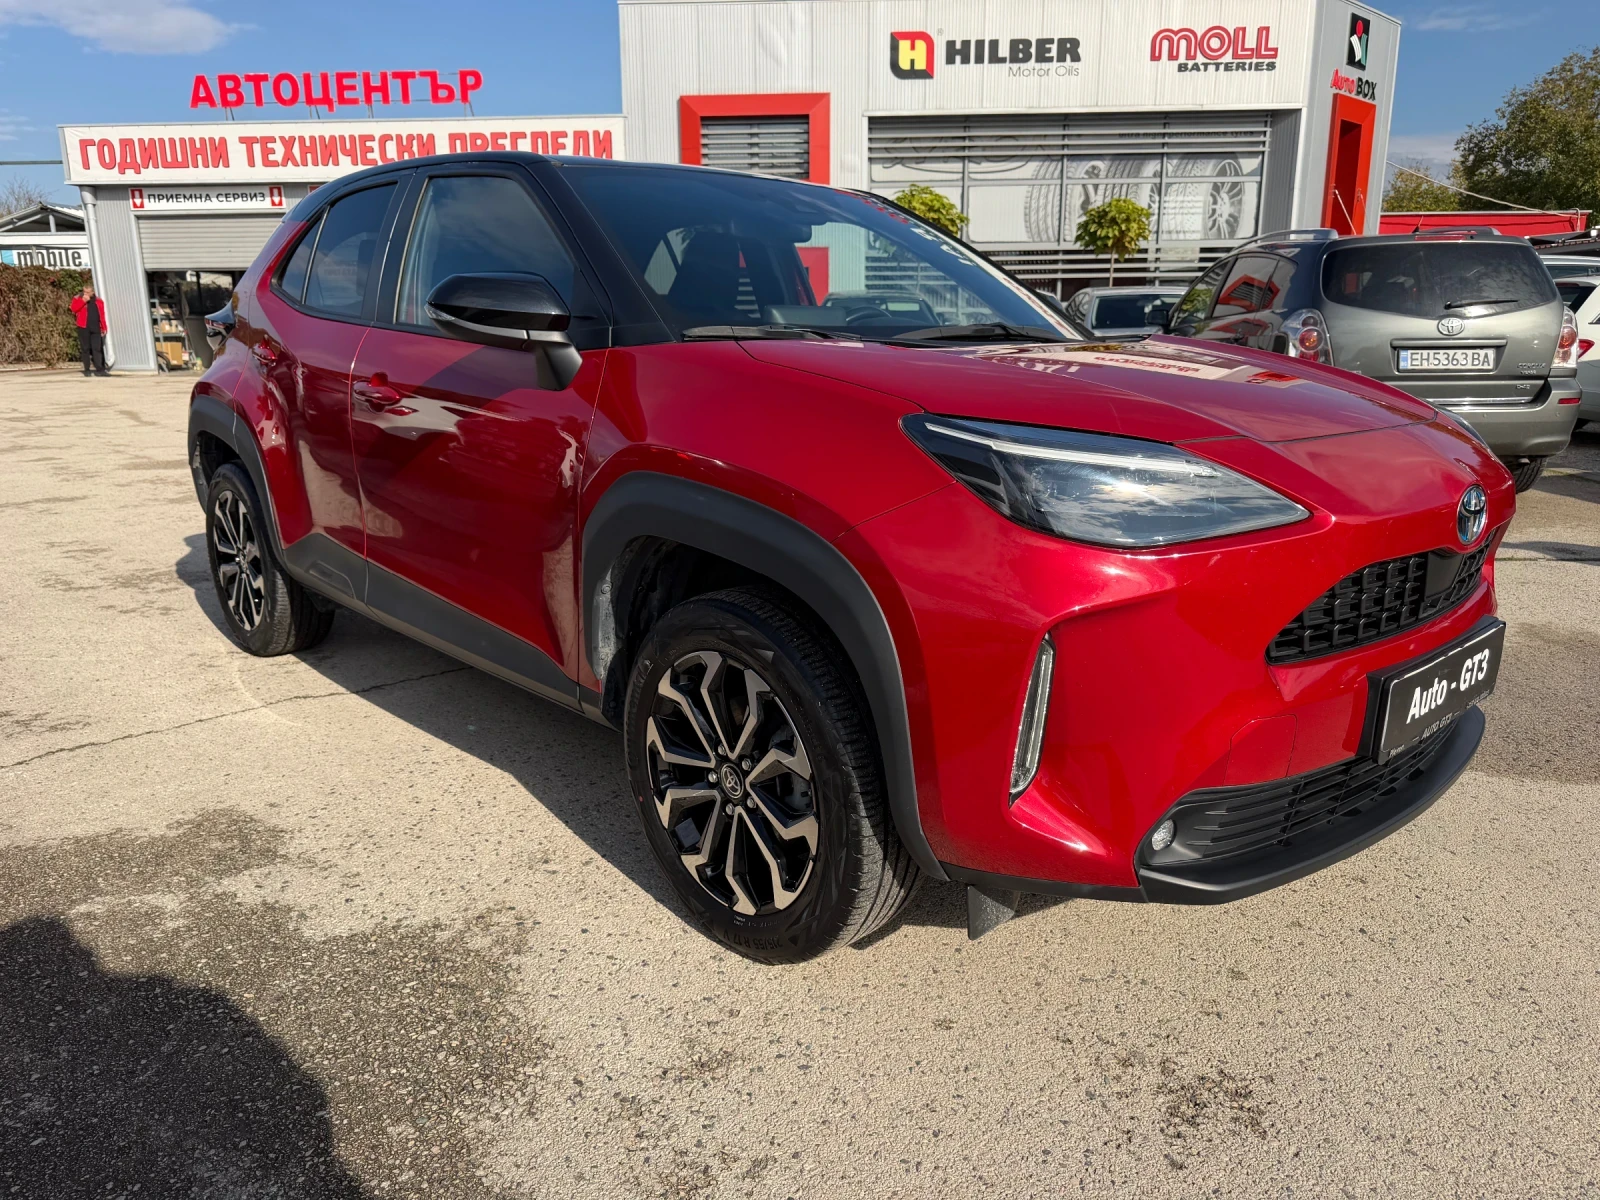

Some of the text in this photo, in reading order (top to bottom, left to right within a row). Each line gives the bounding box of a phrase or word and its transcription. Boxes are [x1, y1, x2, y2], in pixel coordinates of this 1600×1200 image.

[945, 37, 1082, 65] HILBER
[1008, 65, 1080, 78] Motor Oils
[1177, 61, 1277, 73] BATTERIES
[190, 69, 484, 113] АВТОЦЕНТЪР
[1355, 76, 1377, 102] BOX
[78, 136, 230, 174] ГОДИШНИ
[238, 133, 437, 168] ТЕХНИЧЕСКИ
[147, 191, 266, 204] ПРИЕМНА СЕРВИЗ
[1406, 677, 1448, 724] Auto
[1459, 648, 1490, 691] GT3
